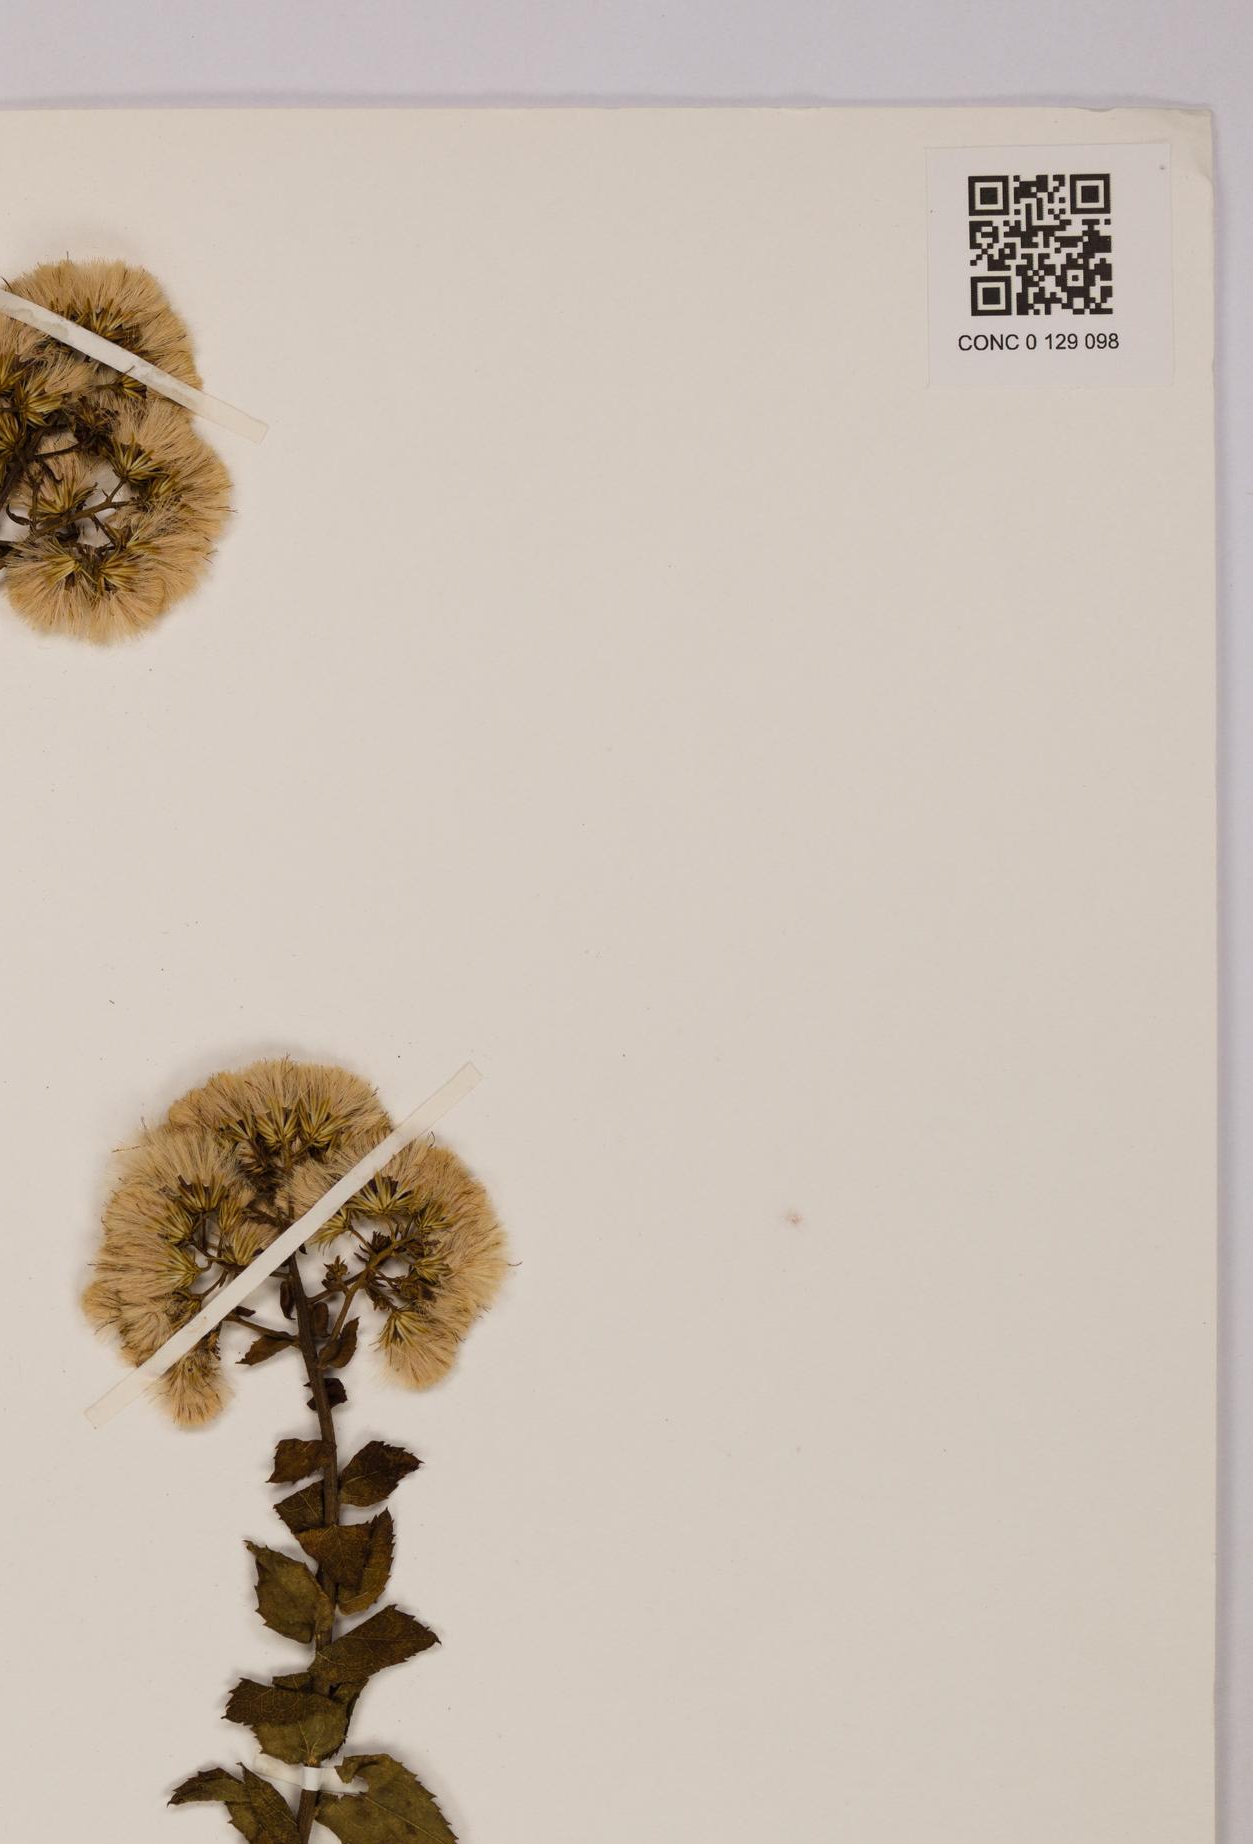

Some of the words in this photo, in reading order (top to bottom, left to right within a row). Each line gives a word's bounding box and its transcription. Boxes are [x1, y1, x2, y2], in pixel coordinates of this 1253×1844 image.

[958, 333, 1020, 352] CONC
[1025, 333, 1037, 351] 0
[1044, 333, 1078, 350] 129
[1084, 332, 1120, 350] 098
